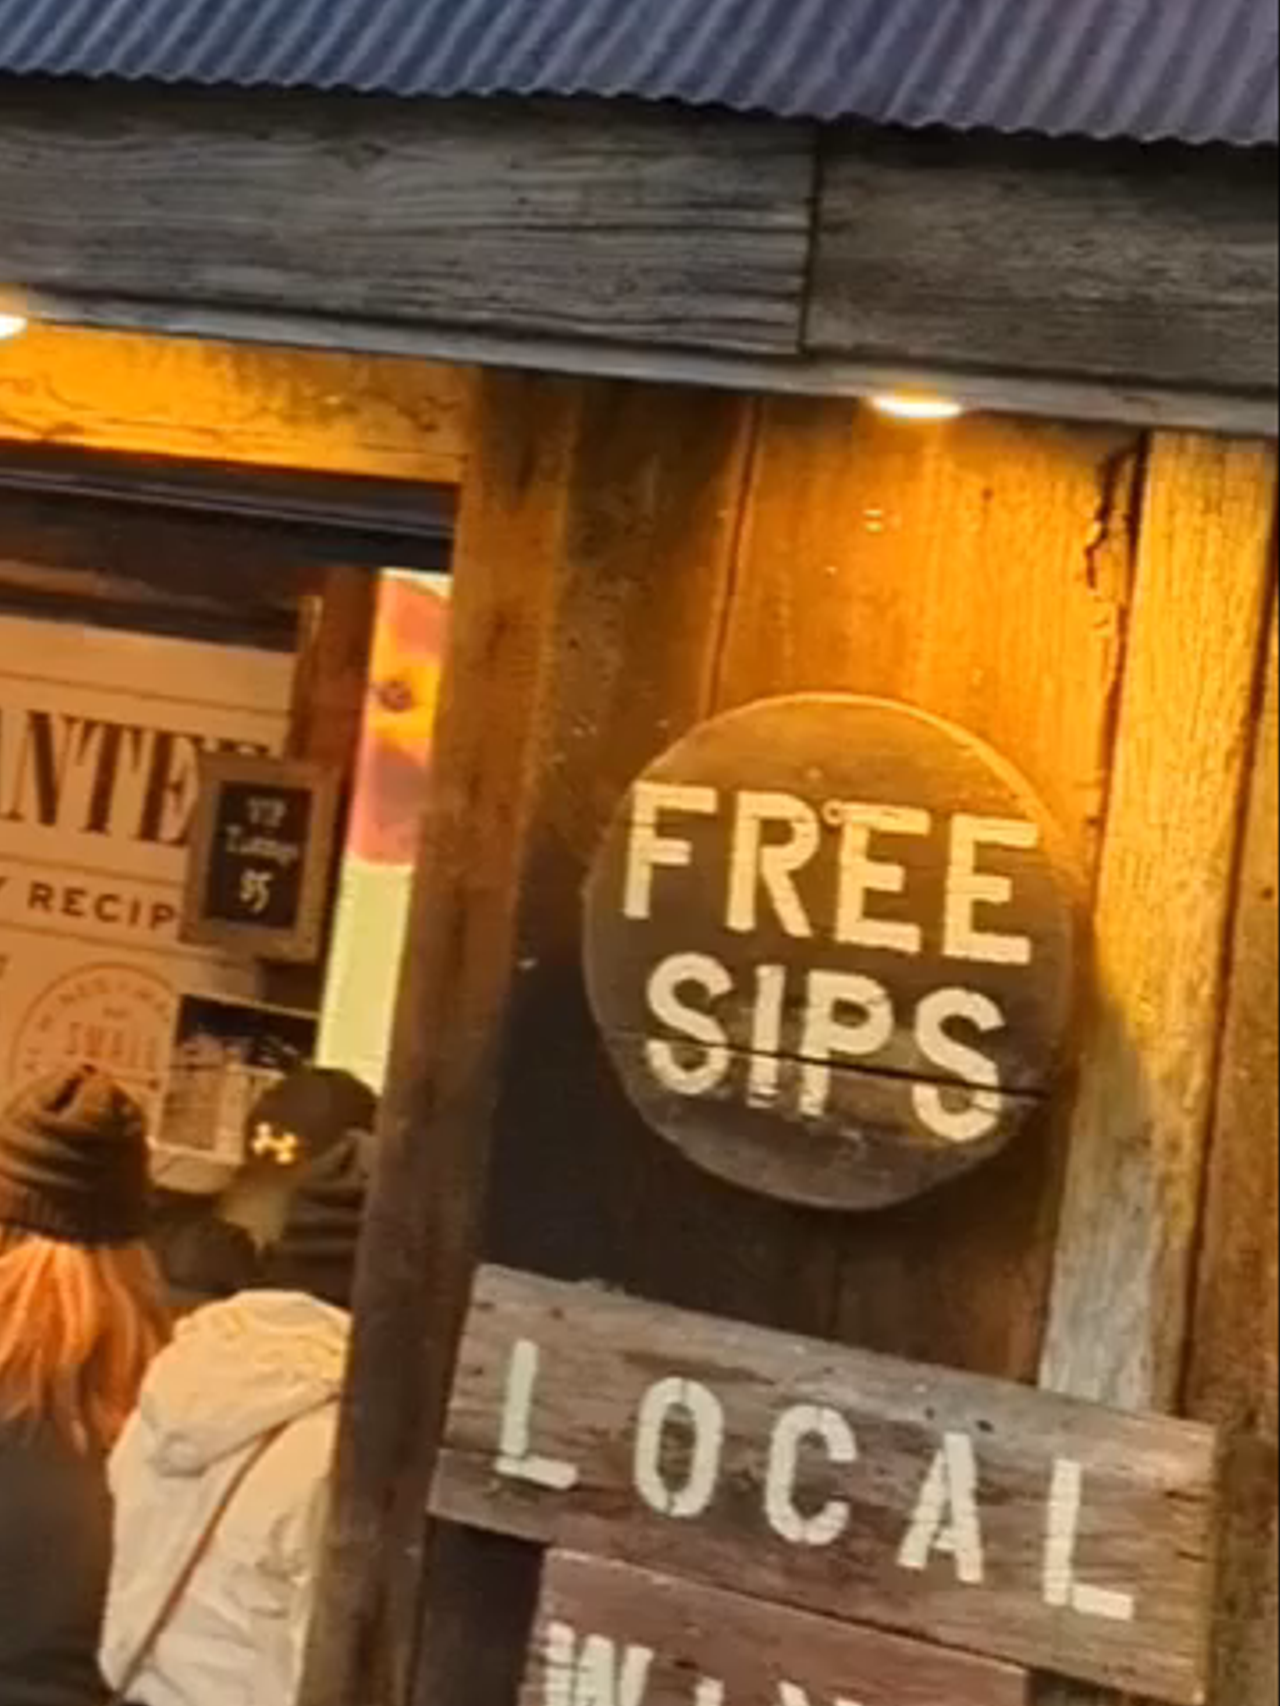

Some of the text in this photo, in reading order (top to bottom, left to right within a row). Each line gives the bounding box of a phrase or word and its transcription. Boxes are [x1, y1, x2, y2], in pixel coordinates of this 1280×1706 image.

[27, 882, 178, 931] RECIP
[624, 777, 1039, 964] FREE
[645, 950, 1009, 1142] SIPS
[496, 1338, 1134, 1623] LOCAL
